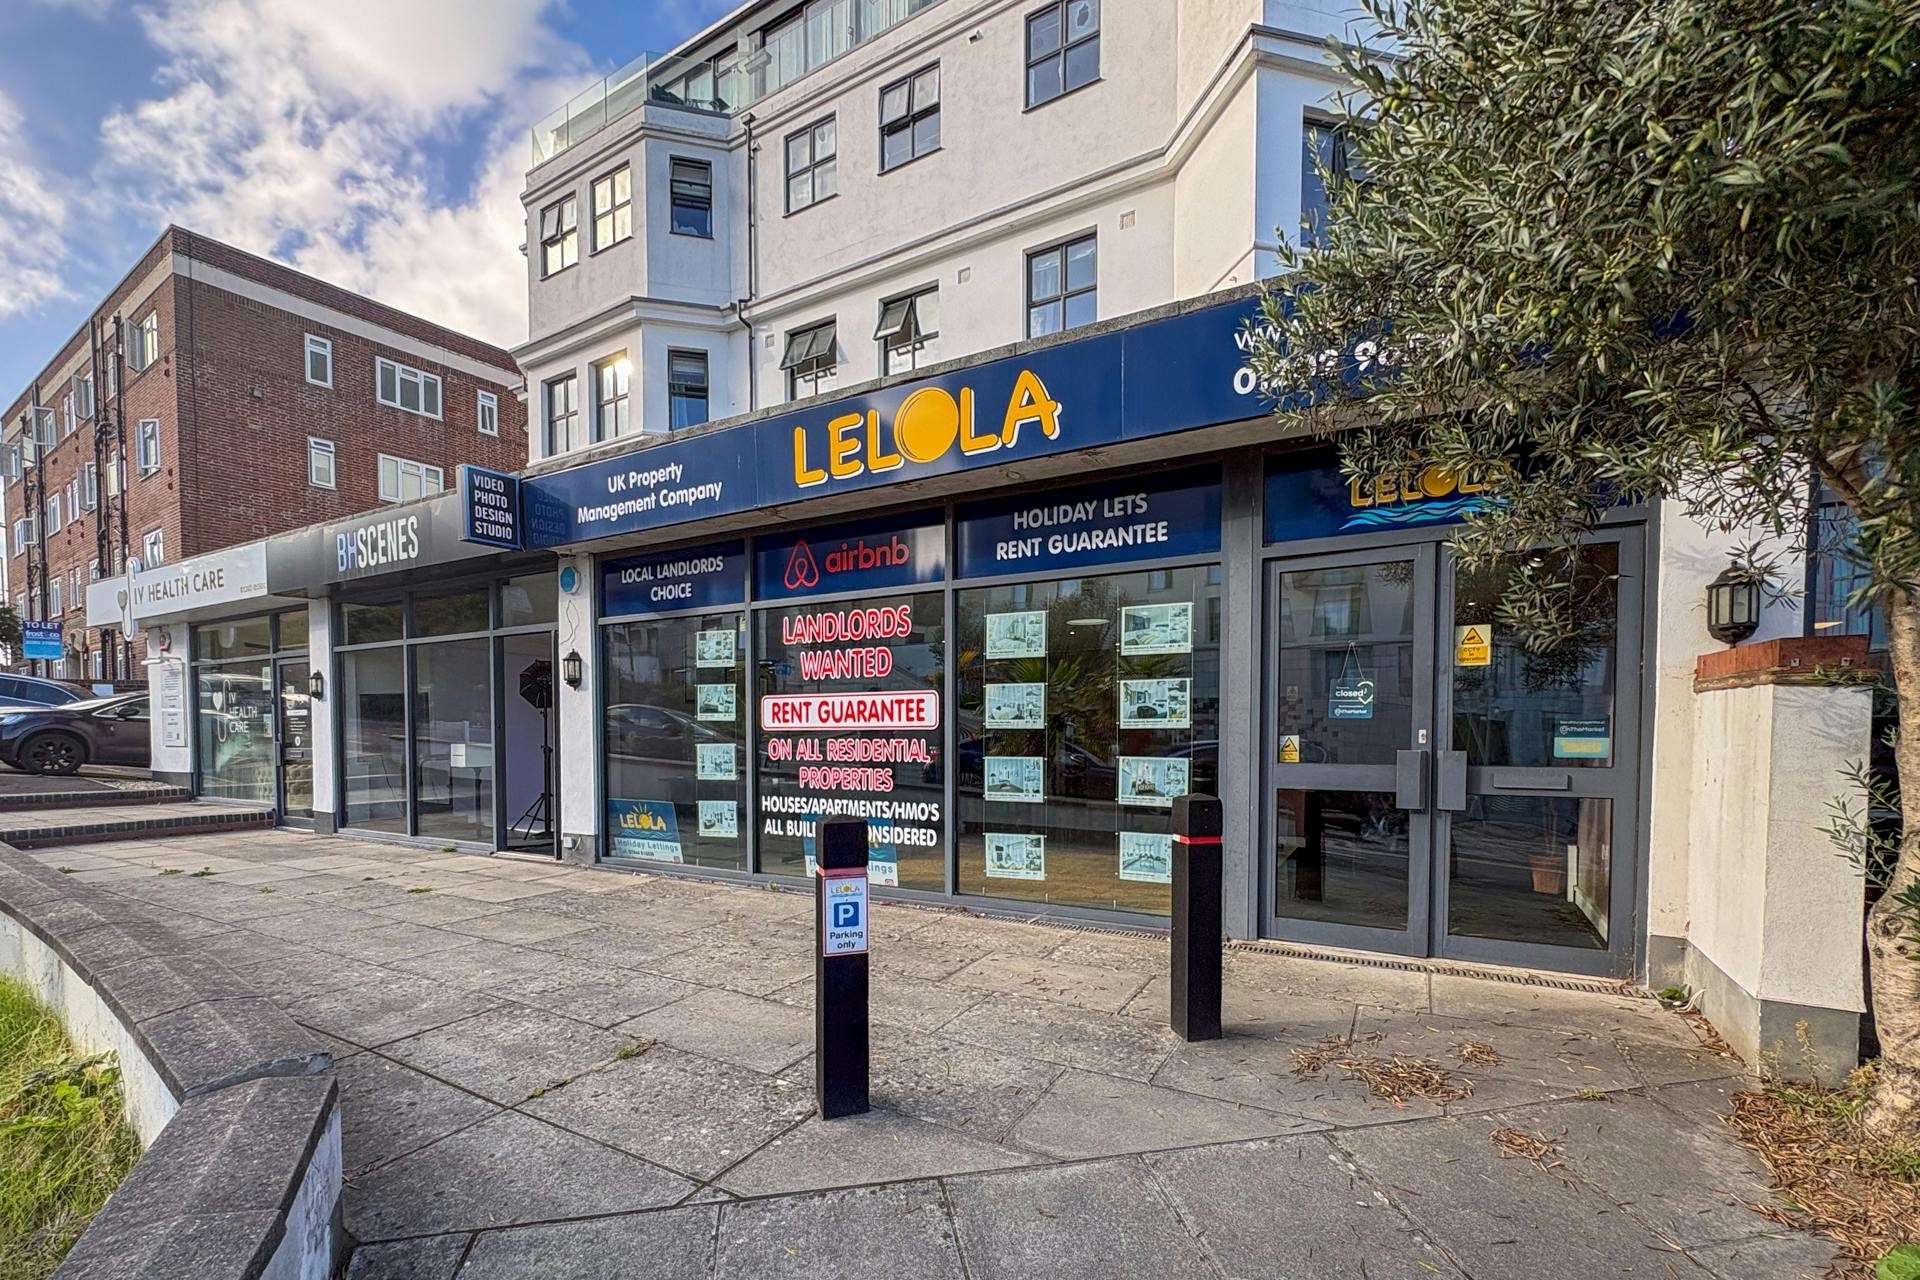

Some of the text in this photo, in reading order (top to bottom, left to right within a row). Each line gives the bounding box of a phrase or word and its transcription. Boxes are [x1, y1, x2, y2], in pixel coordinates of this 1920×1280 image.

[793, 369, 1061, 487] LELOLA
[473, 473, 505, 493] VIDEO
[607, 462, 683, 493] UK Property
[474, 488, 508, 508] PHOTO
[578, 492, 656, 523] Management
[659, 481, 723, 507] Company
[474, 505, 513, 525] DESIGN
[1013, 493, 1148, 530] HOLIDAY LETS
[475, 520, 513, 540] STUDIO
[996, 521, 1169, 561] RENT GUARANTEE
[336, 515, 419, 573] BHSCENES
[825, 535, 911, 574] airbnb
[621, 556, 724, 584] LOCAL LANDLORDS
[134, 586, 144, 605] IV
[148, 575, 189, 602] HEALTH
[193, 568, 224, 593] CARE
[651, 582, 692, 602] CHOICE
[783, 605, 912, 645] LANDLORDS
[800, 646, 893, 681] WANTED
[228, 692, 236, 704] IV
[1335, 689, 1364, 697] closed
[229, 706, 258, 718] HEALTH
[771, 698, 926, 724] RENT GUARANTEE
[229, 721, 250, 734] CARE
[768, 738, 931, 763] ON ALL RESIDENTIAL
[799, 766, 894, 792] PROPERTIES
[761, 796, 940, 822] HOUSES/APARTMENTS/HMO'S
[619, 813, 667, 832] LELOLA
[764, 818, 785, 836] ALL
[868, 825, 938, 847] NSIDERED
[617, 838, 646, 849] Holiday
[647, 840, 679, 853] Lettings
[830, 886, 860, 894] LELOLA
[838, 904, 855, 926] P
[830, 931, 864, 940] Parking
[837, 940, 857, 949] only
